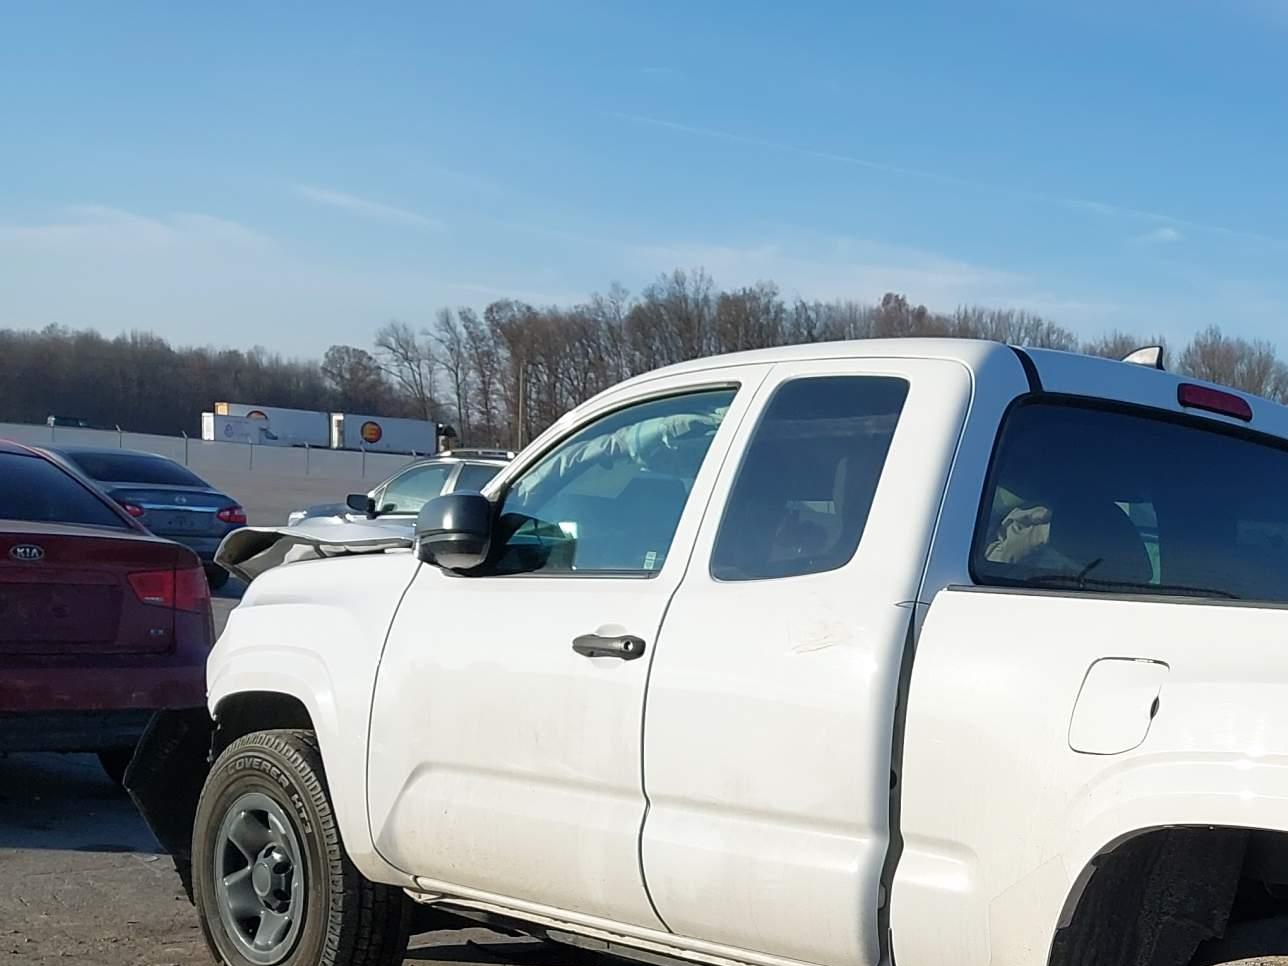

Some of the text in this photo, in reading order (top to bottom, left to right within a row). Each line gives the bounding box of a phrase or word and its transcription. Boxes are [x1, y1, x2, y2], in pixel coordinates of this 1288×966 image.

[16, 547, 39, 557] KIA
[217, 757, 312, 834] COVERER HT3
